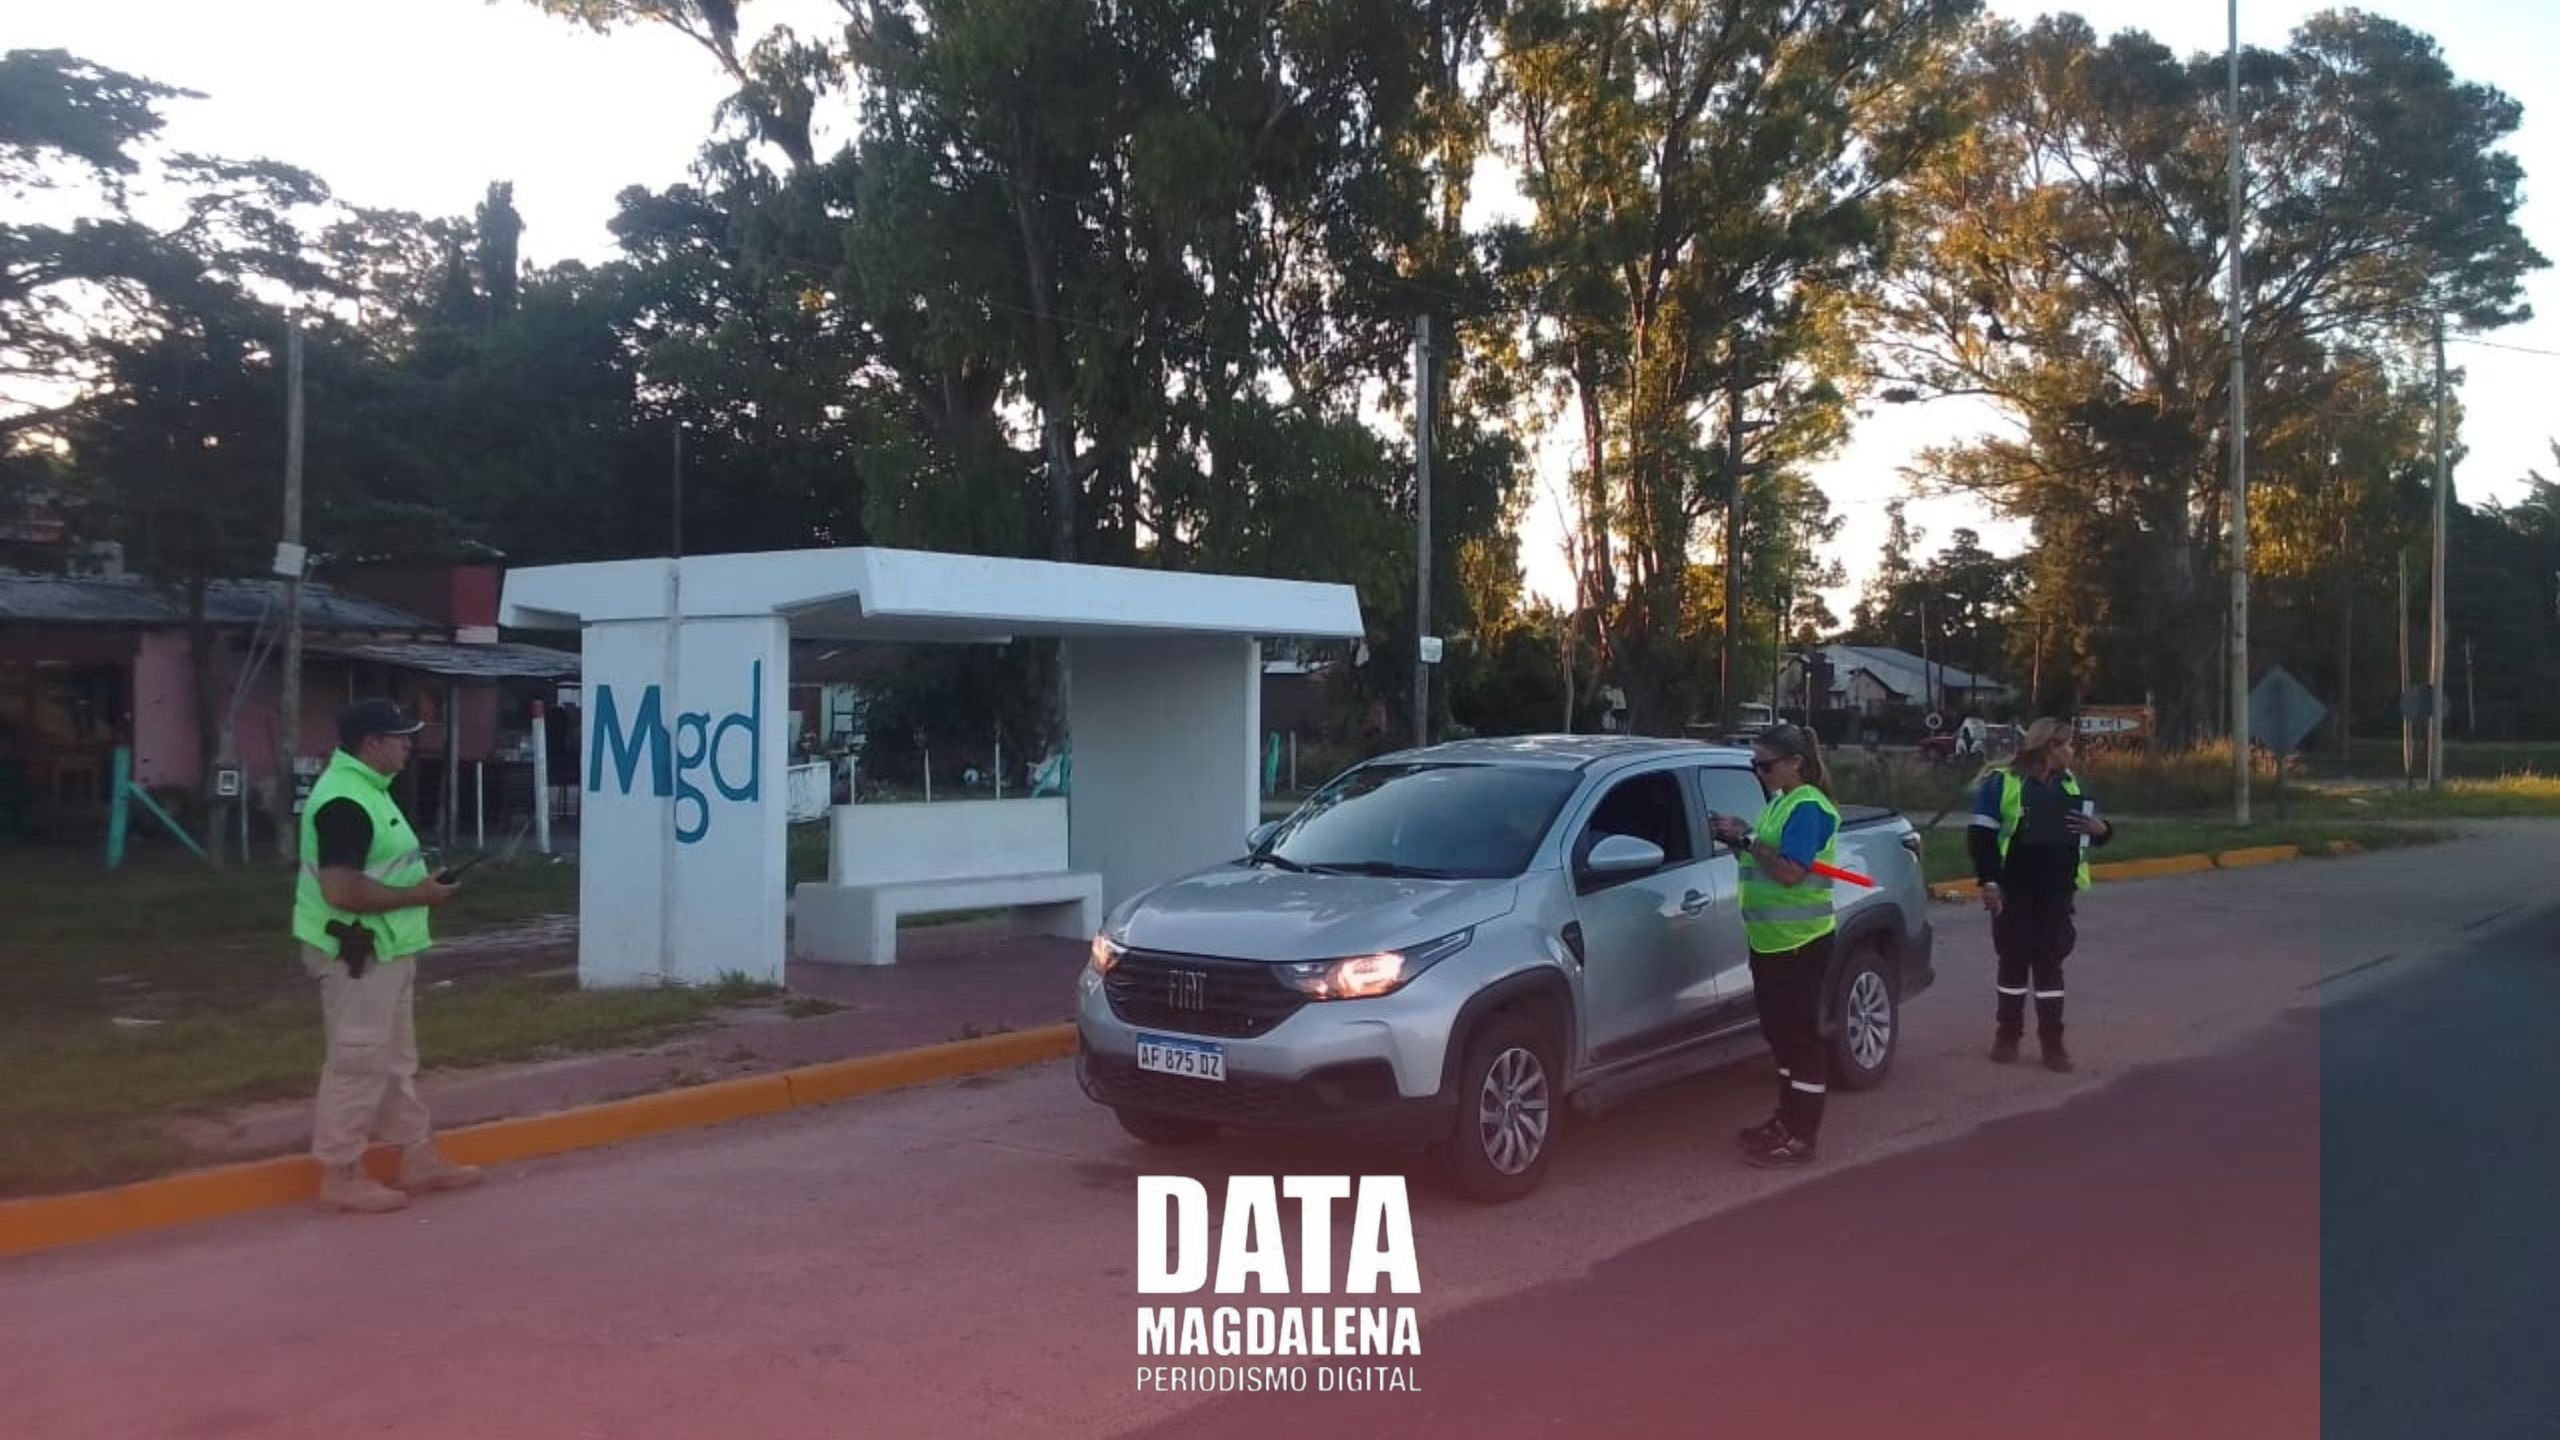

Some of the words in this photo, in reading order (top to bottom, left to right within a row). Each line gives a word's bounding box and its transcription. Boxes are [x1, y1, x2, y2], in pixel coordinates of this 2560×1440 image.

[589, 659, 761, 843] Mgd
[1168, 969, 1207, 1011] FIAT
[1141, 1045, 1159, 1067] AF
[1165, 1049, 1194, 1073] 875
[1199, 1053, 1219, 1077] DZ
